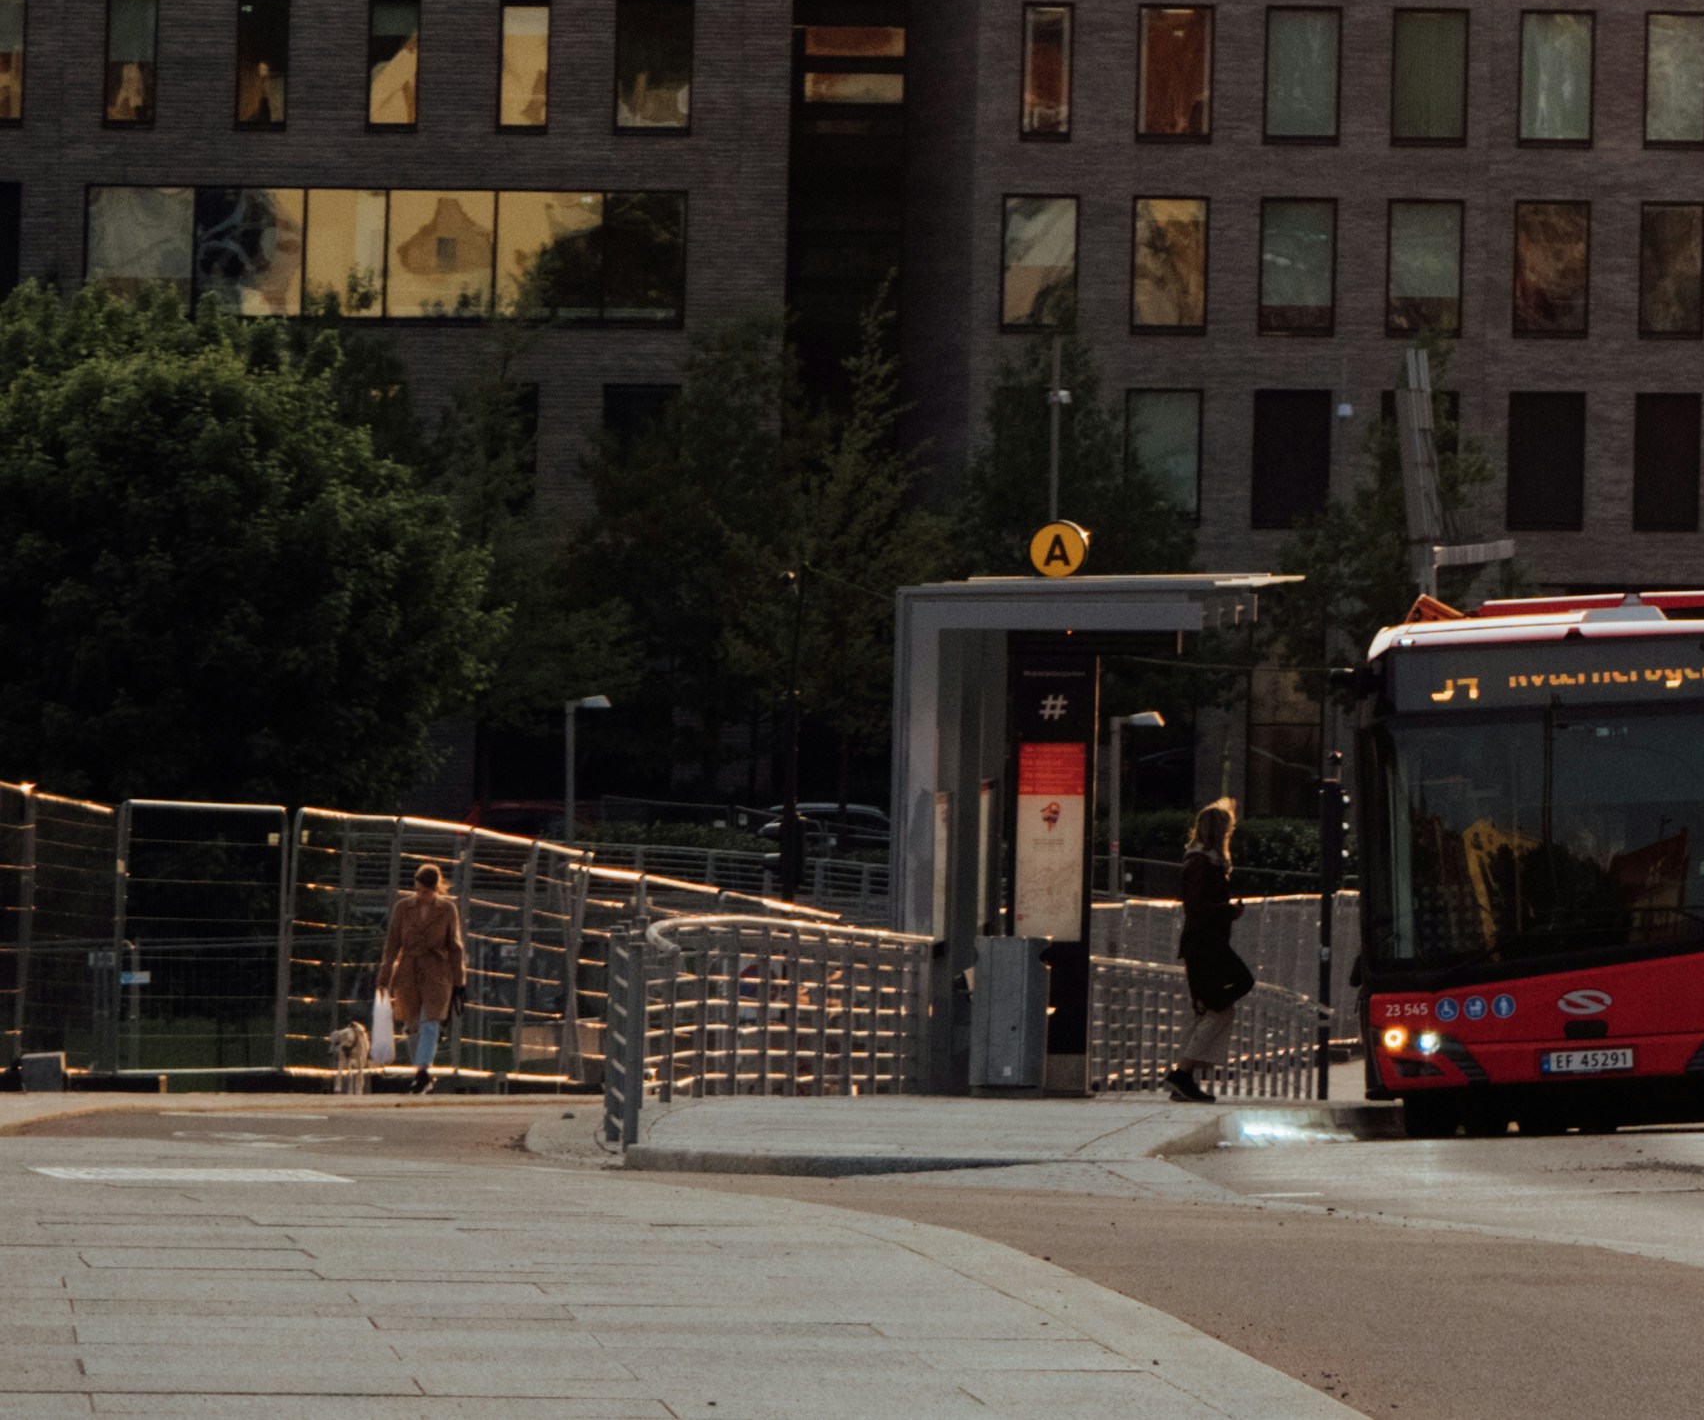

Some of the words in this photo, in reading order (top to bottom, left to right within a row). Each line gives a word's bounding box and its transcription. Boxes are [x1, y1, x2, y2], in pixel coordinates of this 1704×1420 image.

[1043, 534, 1071, 566] A
[1385, 1004, 1401, 1017] 23
[1404, 1003, 1429, 1016] 545
[1556, 1054, 1573, 1069] EF
[1581, 1051, 1627, 1068] 45291
